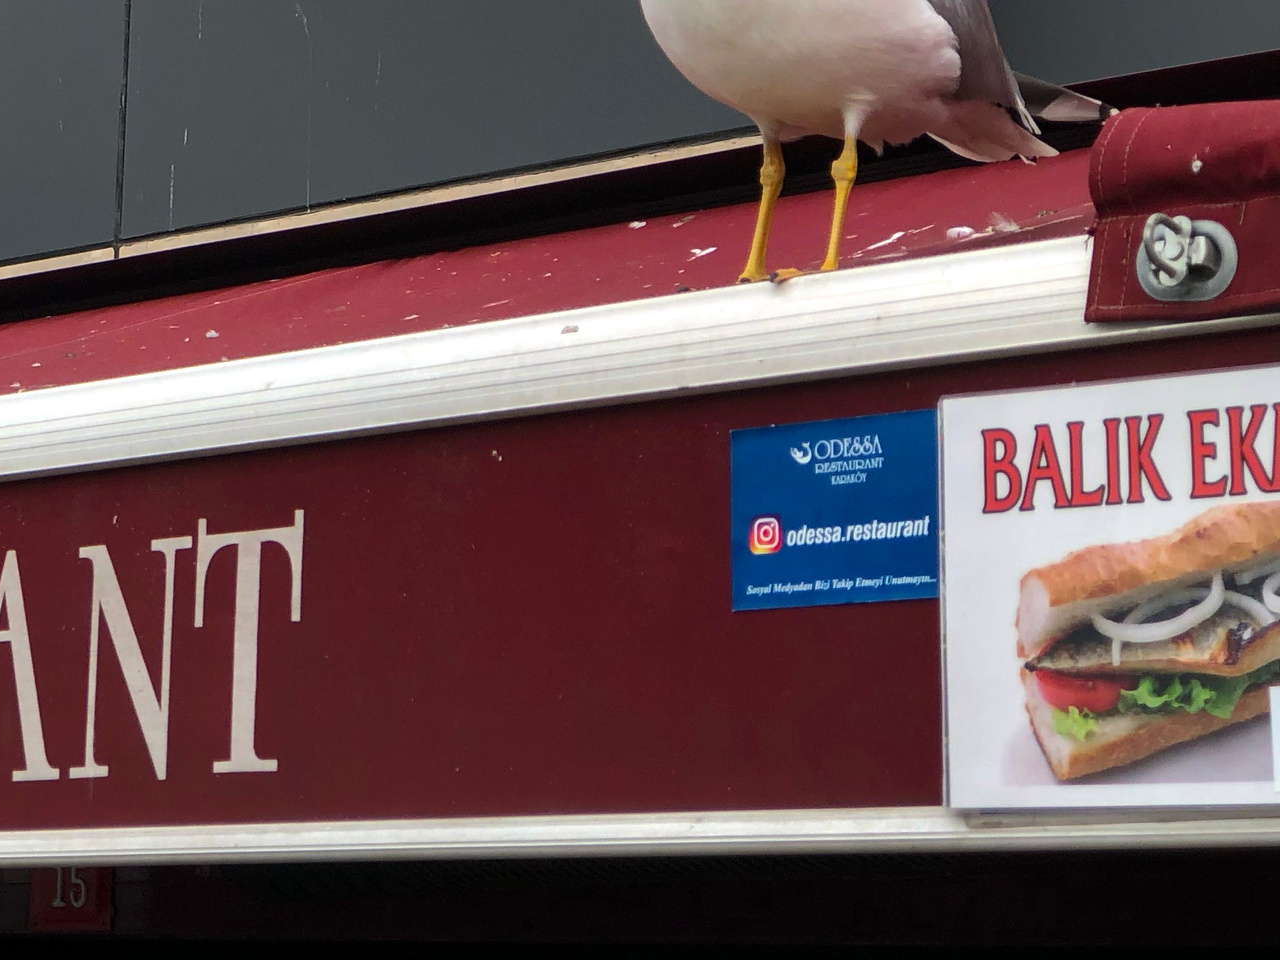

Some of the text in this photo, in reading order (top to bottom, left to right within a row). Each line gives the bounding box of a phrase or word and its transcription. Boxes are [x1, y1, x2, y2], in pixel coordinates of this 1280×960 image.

[814, 434, 883, 460] ODESSA
[981, 402, 1280, 514] BALIK EK
[815, 457, 885, 474] RESTAURANT
[786, 515, 930, 547] odessa.restaurant
[746, 584, 772, 597] Sosyal
[773, 581, 813, 595] Medyadan
[814, 577, 830, 591] Bizi
[832, 578, 854, 590] Takip
[855, 574, 884, 589] Etmeyi
[52, 866, 88, 907] 15
